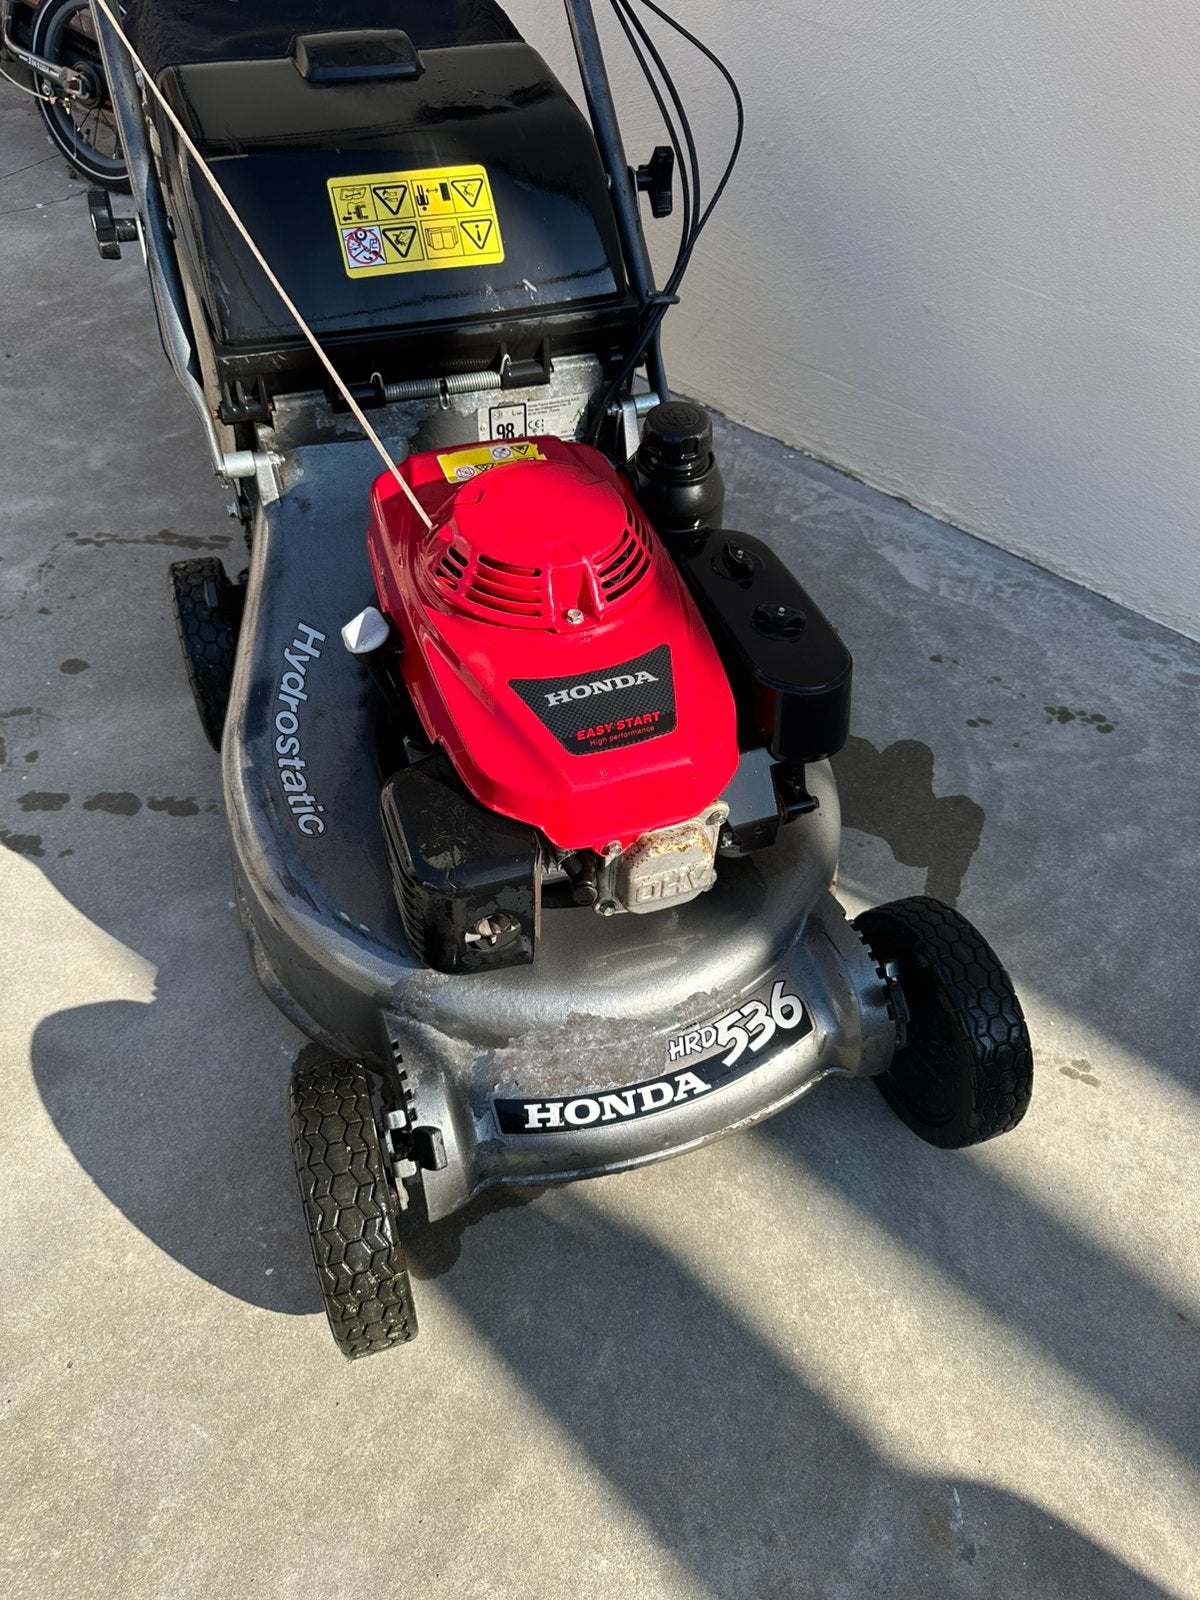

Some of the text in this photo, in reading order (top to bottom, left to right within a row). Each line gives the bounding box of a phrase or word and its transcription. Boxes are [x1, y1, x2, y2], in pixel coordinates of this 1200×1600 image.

[496, 422, 515, 439] 98
[544, 670, 659, 707] HONDA
[275, 622, 326, 835] Hydrostatic
[576, 711, 661, 741] EASY START
[590, 725, 655, 747] High performance
[635, 863, 710, 903] OHV
[524, 1071, 711, 1129] HONDA
